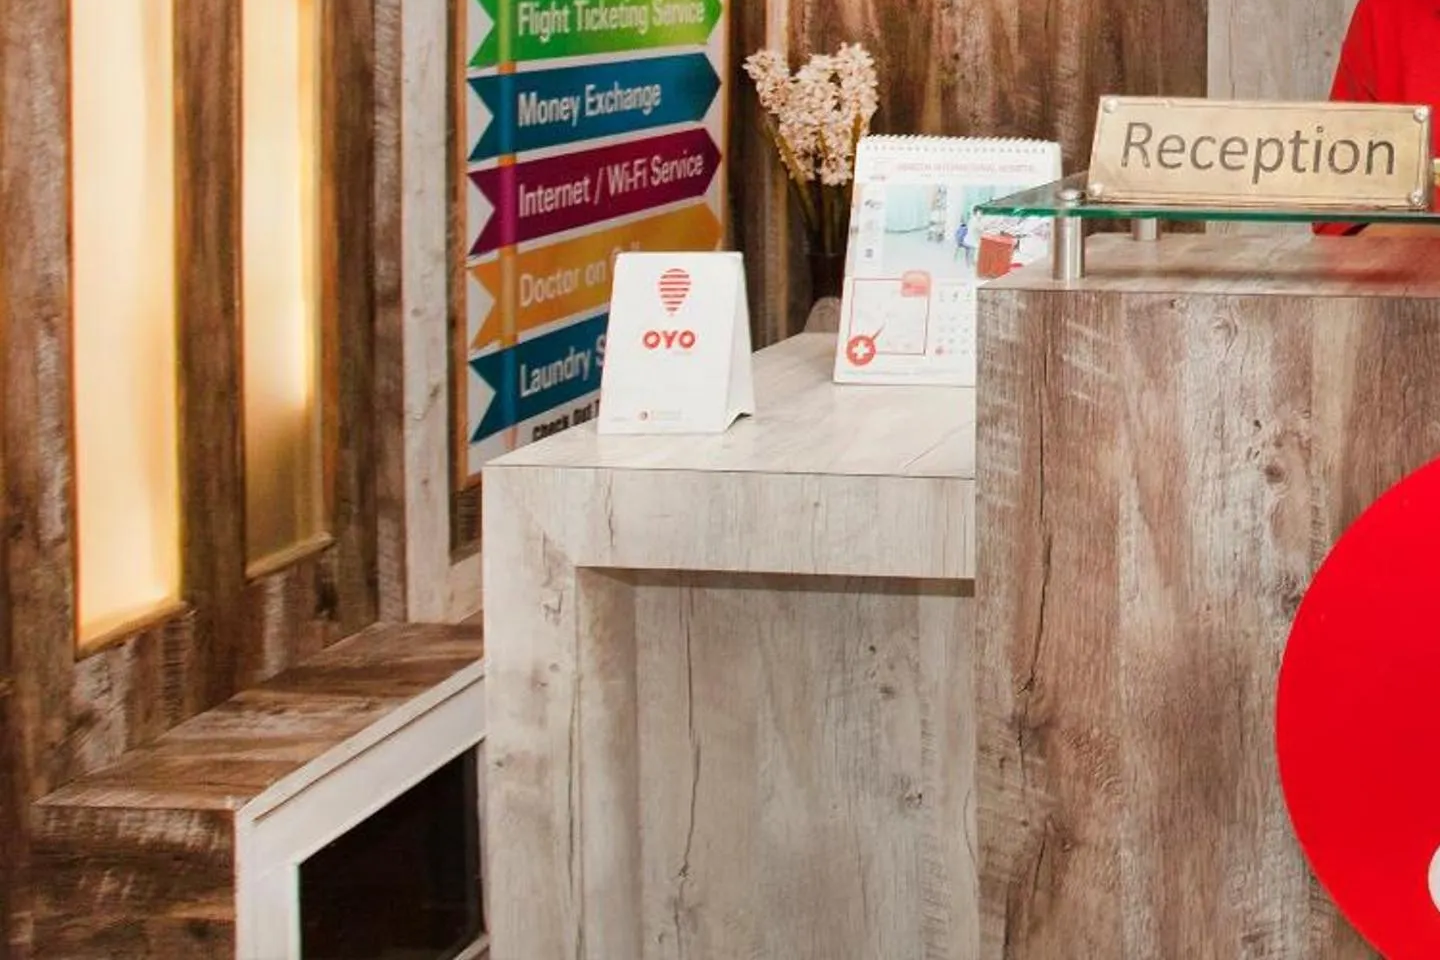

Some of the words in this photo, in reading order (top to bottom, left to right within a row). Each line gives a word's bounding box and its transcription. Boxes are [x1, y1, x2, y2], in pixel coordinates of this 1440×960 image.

[518, 1, 570, 43] Flight
[518, 92, 580, 127] Money
[585, 82, 662, 117] Exchange
[1120, 120, 1396, 184] Reception
[519, 176, 591, 218] Internet
[607, 160, 649, 195] Wi-Fi
[650, 150, 704, 187] Service
[520, 267, 581, 307] Doctor
[585, 260, 607, 286] on
[643, 329, 696, 350] OYO
[520, 346, 592, 398] Laundry
